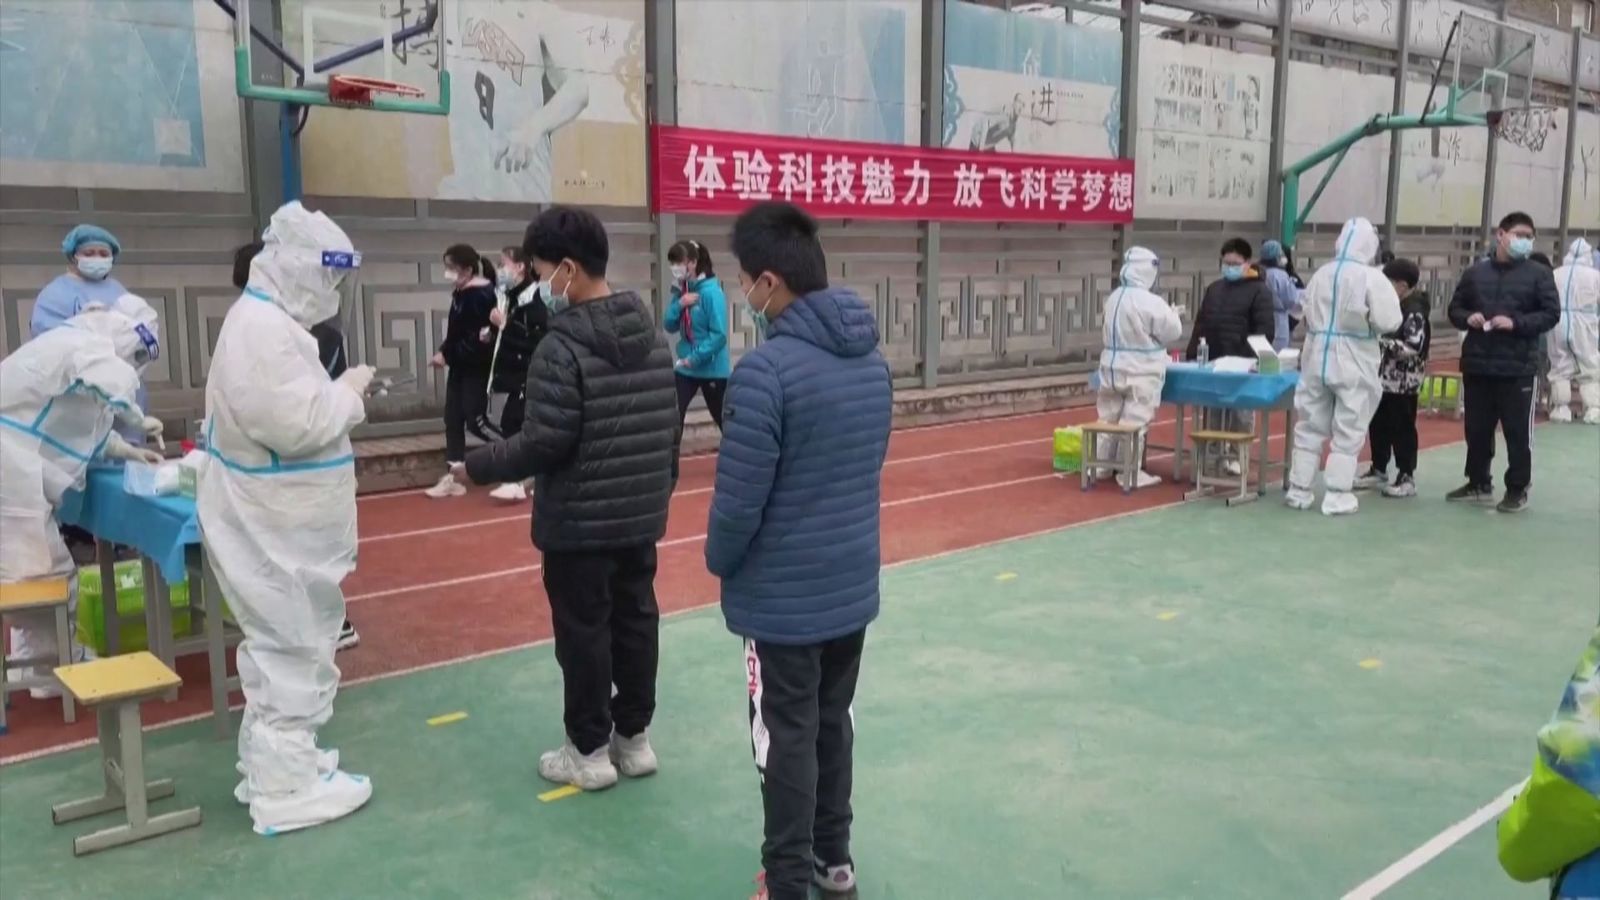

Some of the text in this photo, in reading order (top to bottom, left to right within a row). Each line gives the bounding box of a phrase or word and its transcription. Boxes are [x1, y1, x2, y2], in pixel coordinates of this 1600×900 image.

[683, 144, 1133, 212] 体验科技魅力 放飞科学梦想
